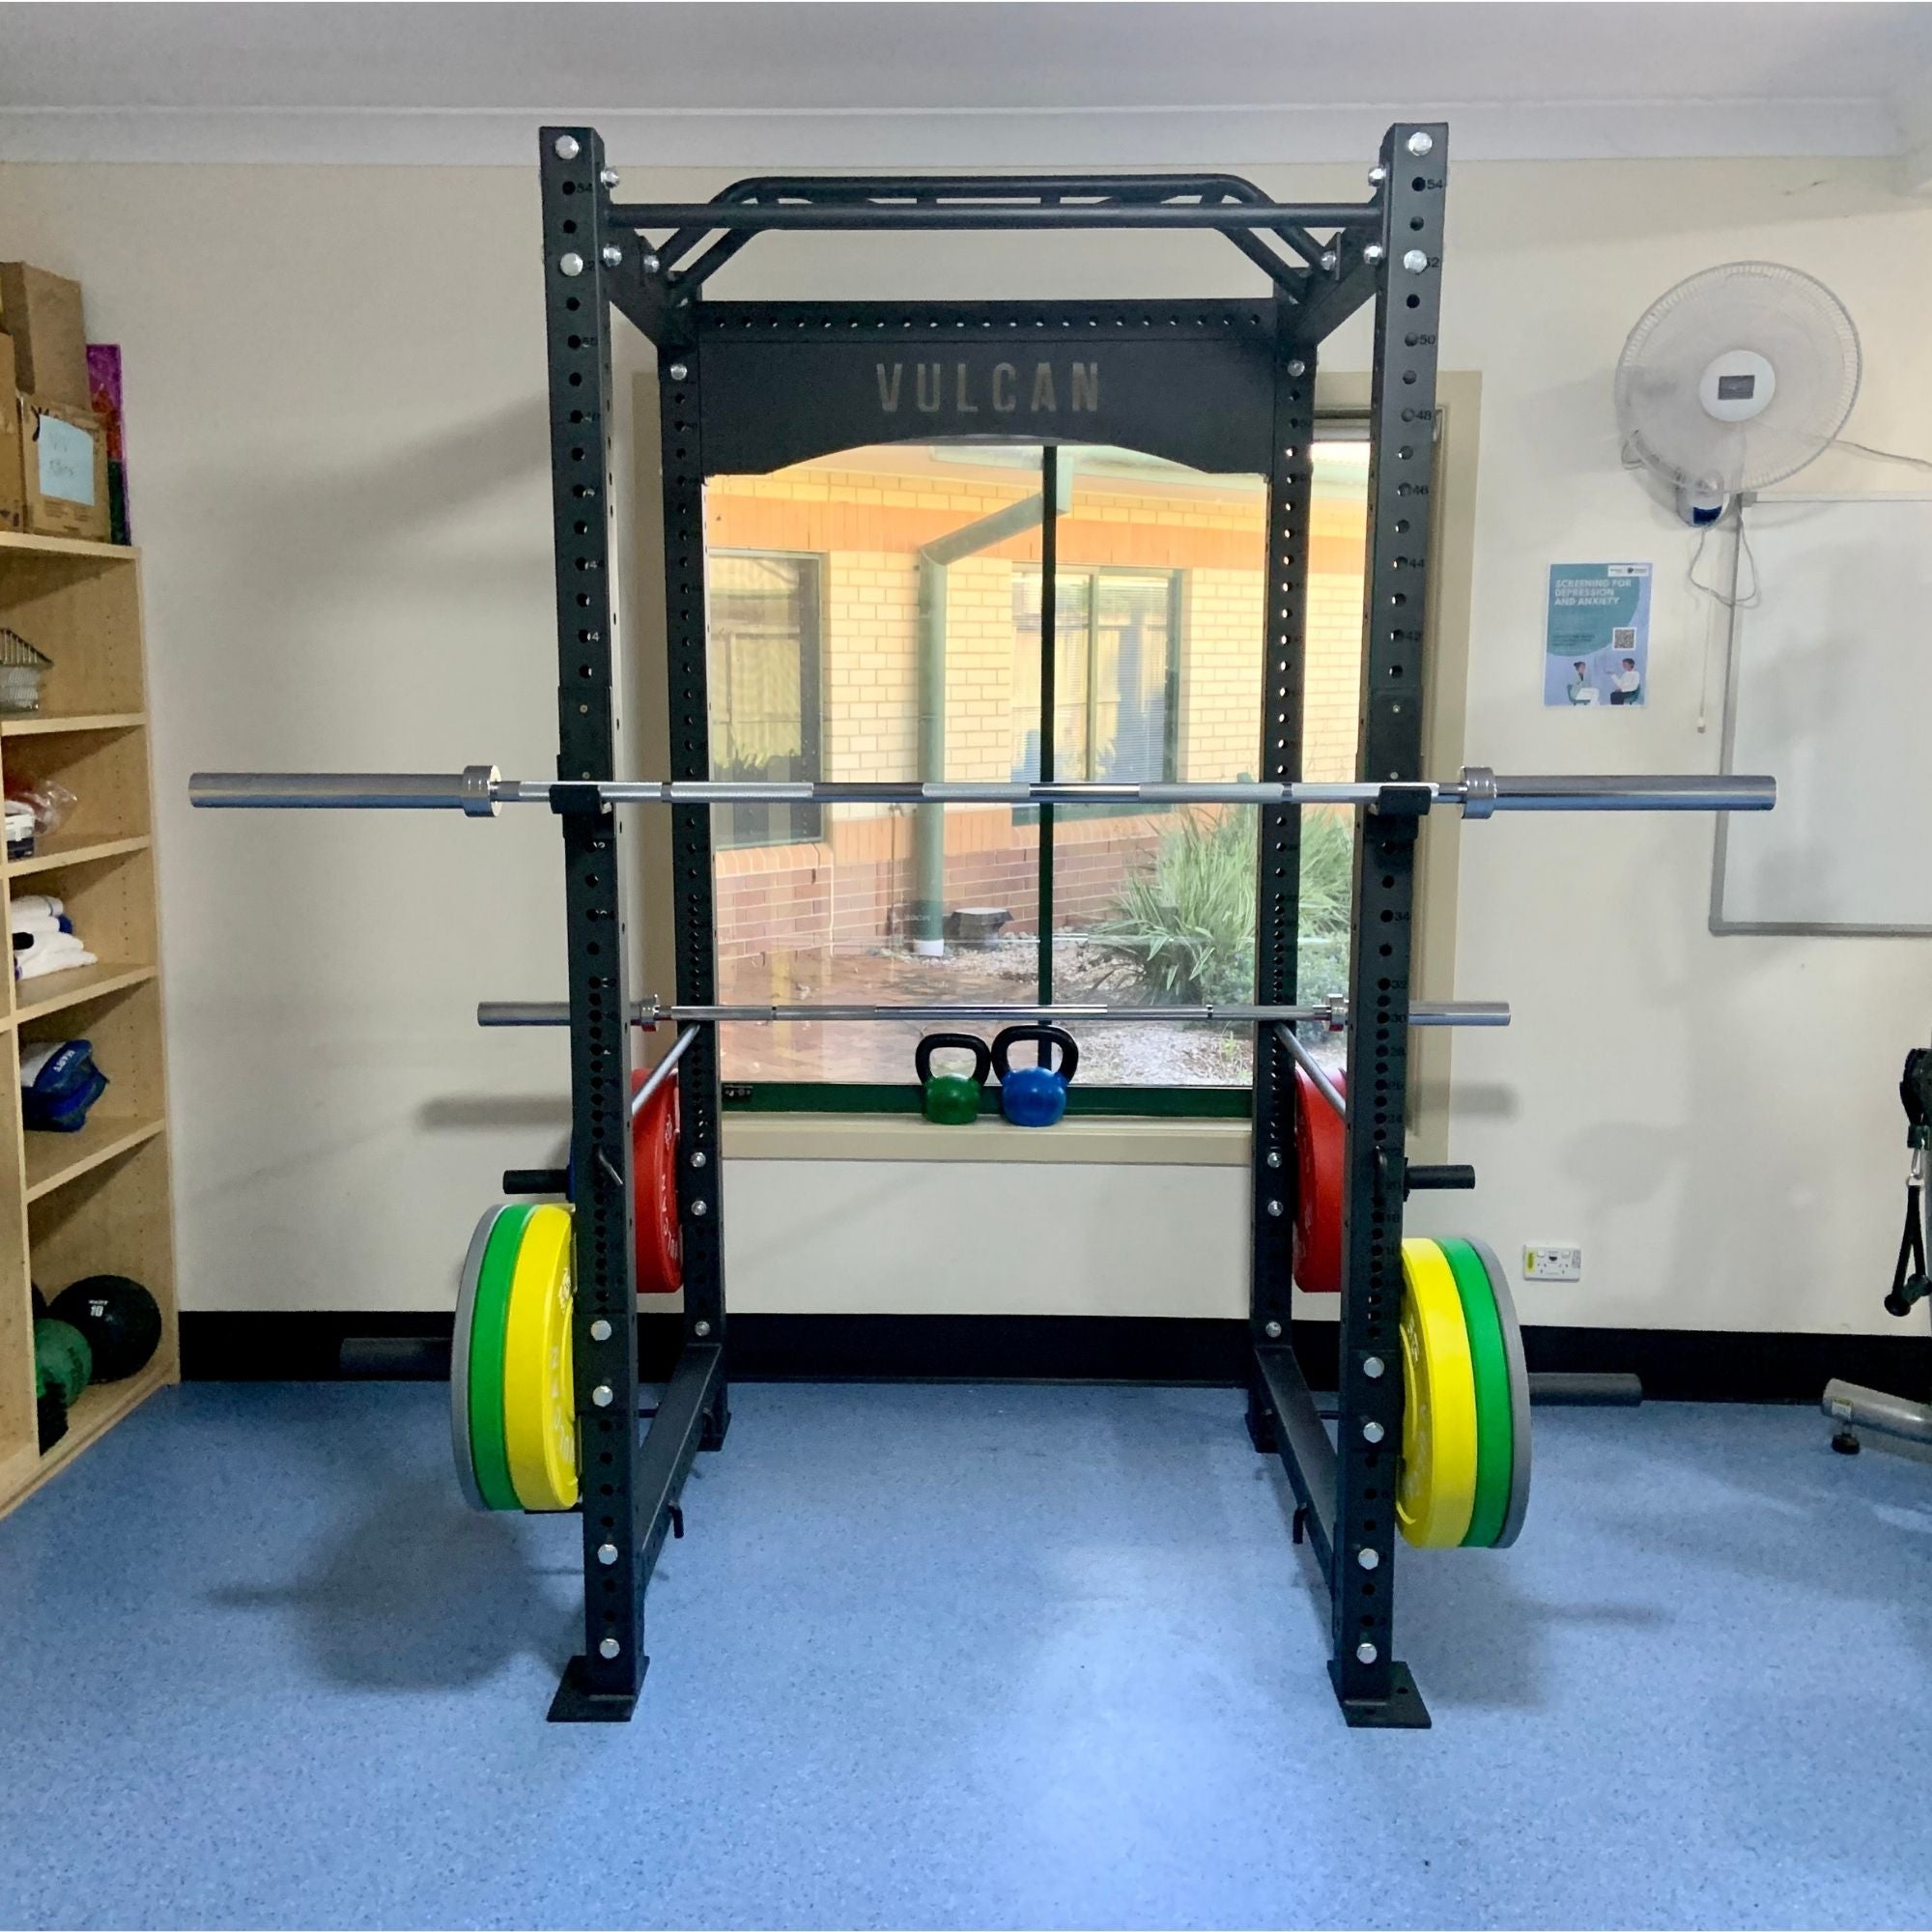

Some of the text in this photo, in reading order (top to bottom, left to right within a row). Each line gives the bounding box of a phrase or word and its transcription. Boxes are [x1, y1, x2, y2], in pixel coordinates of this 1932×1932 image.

[1427, 179, 1443, 189] 54
[1419, 334, 1436, 345] 50
[875, 362, 1098, 412] VULCAN
[1415, 410, 1432, 420] 48
[1556, 579, 1632, 588] SCREENING FOR
[1554, 587, 1615, 597] DEPRESSION
[1554, 596, 1620, 606] AND ANXIETY
[1392, 980, 1407, 989] 32
[90, 1305, 104, 1318] 10
